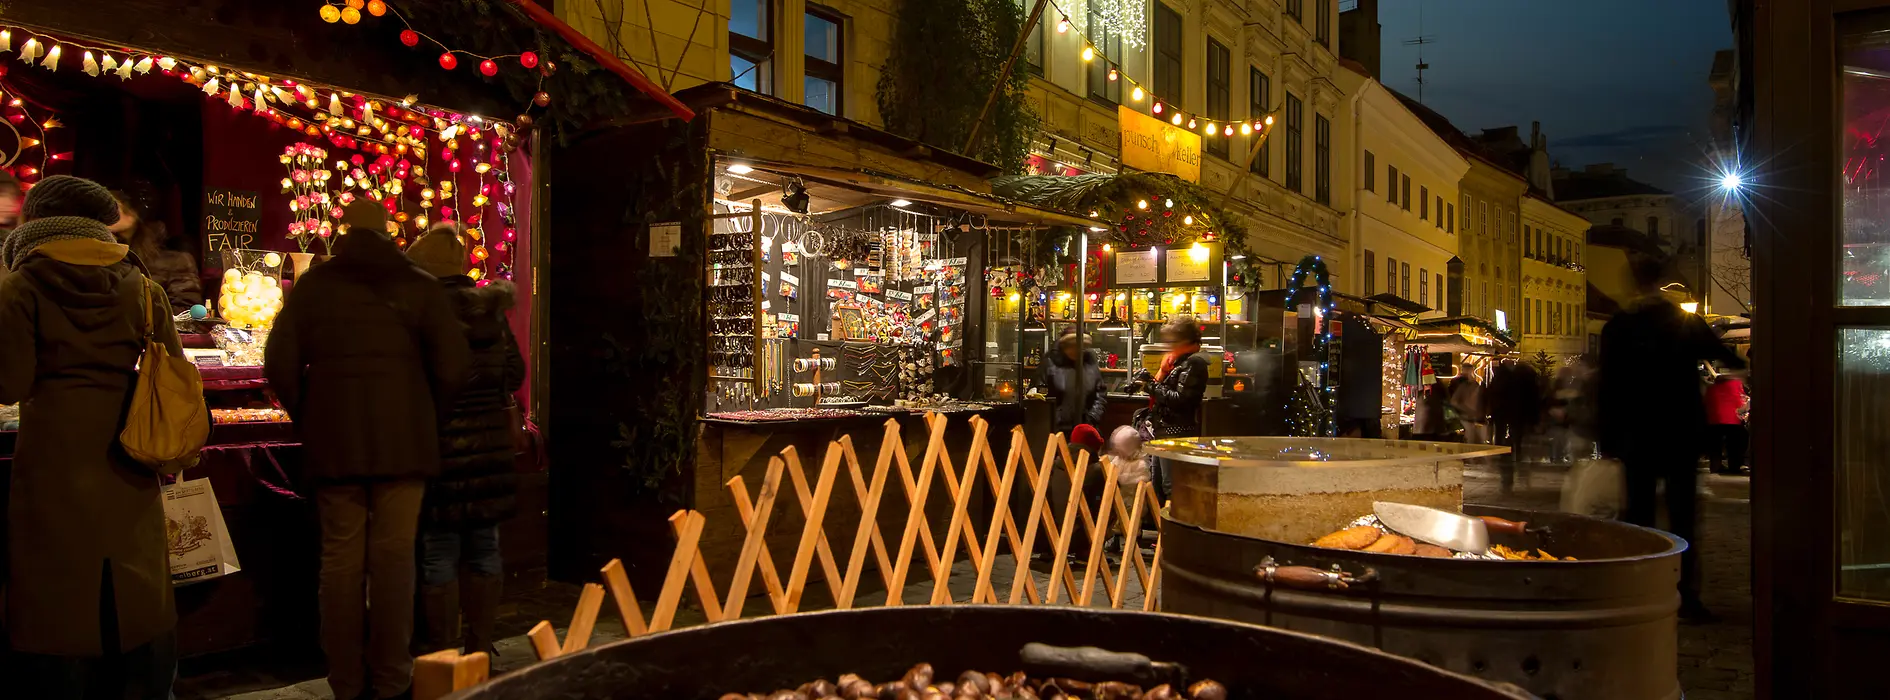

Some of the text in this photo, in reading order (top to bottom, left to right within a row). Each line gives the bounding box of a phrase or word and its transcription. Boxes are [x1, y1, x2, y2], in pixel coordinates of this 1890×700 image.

[1124, 129, 1159, 153] punsch
[206, 215, 258, 232] PRODUZIEREN
[208, 233, 253, 251] FAIR
